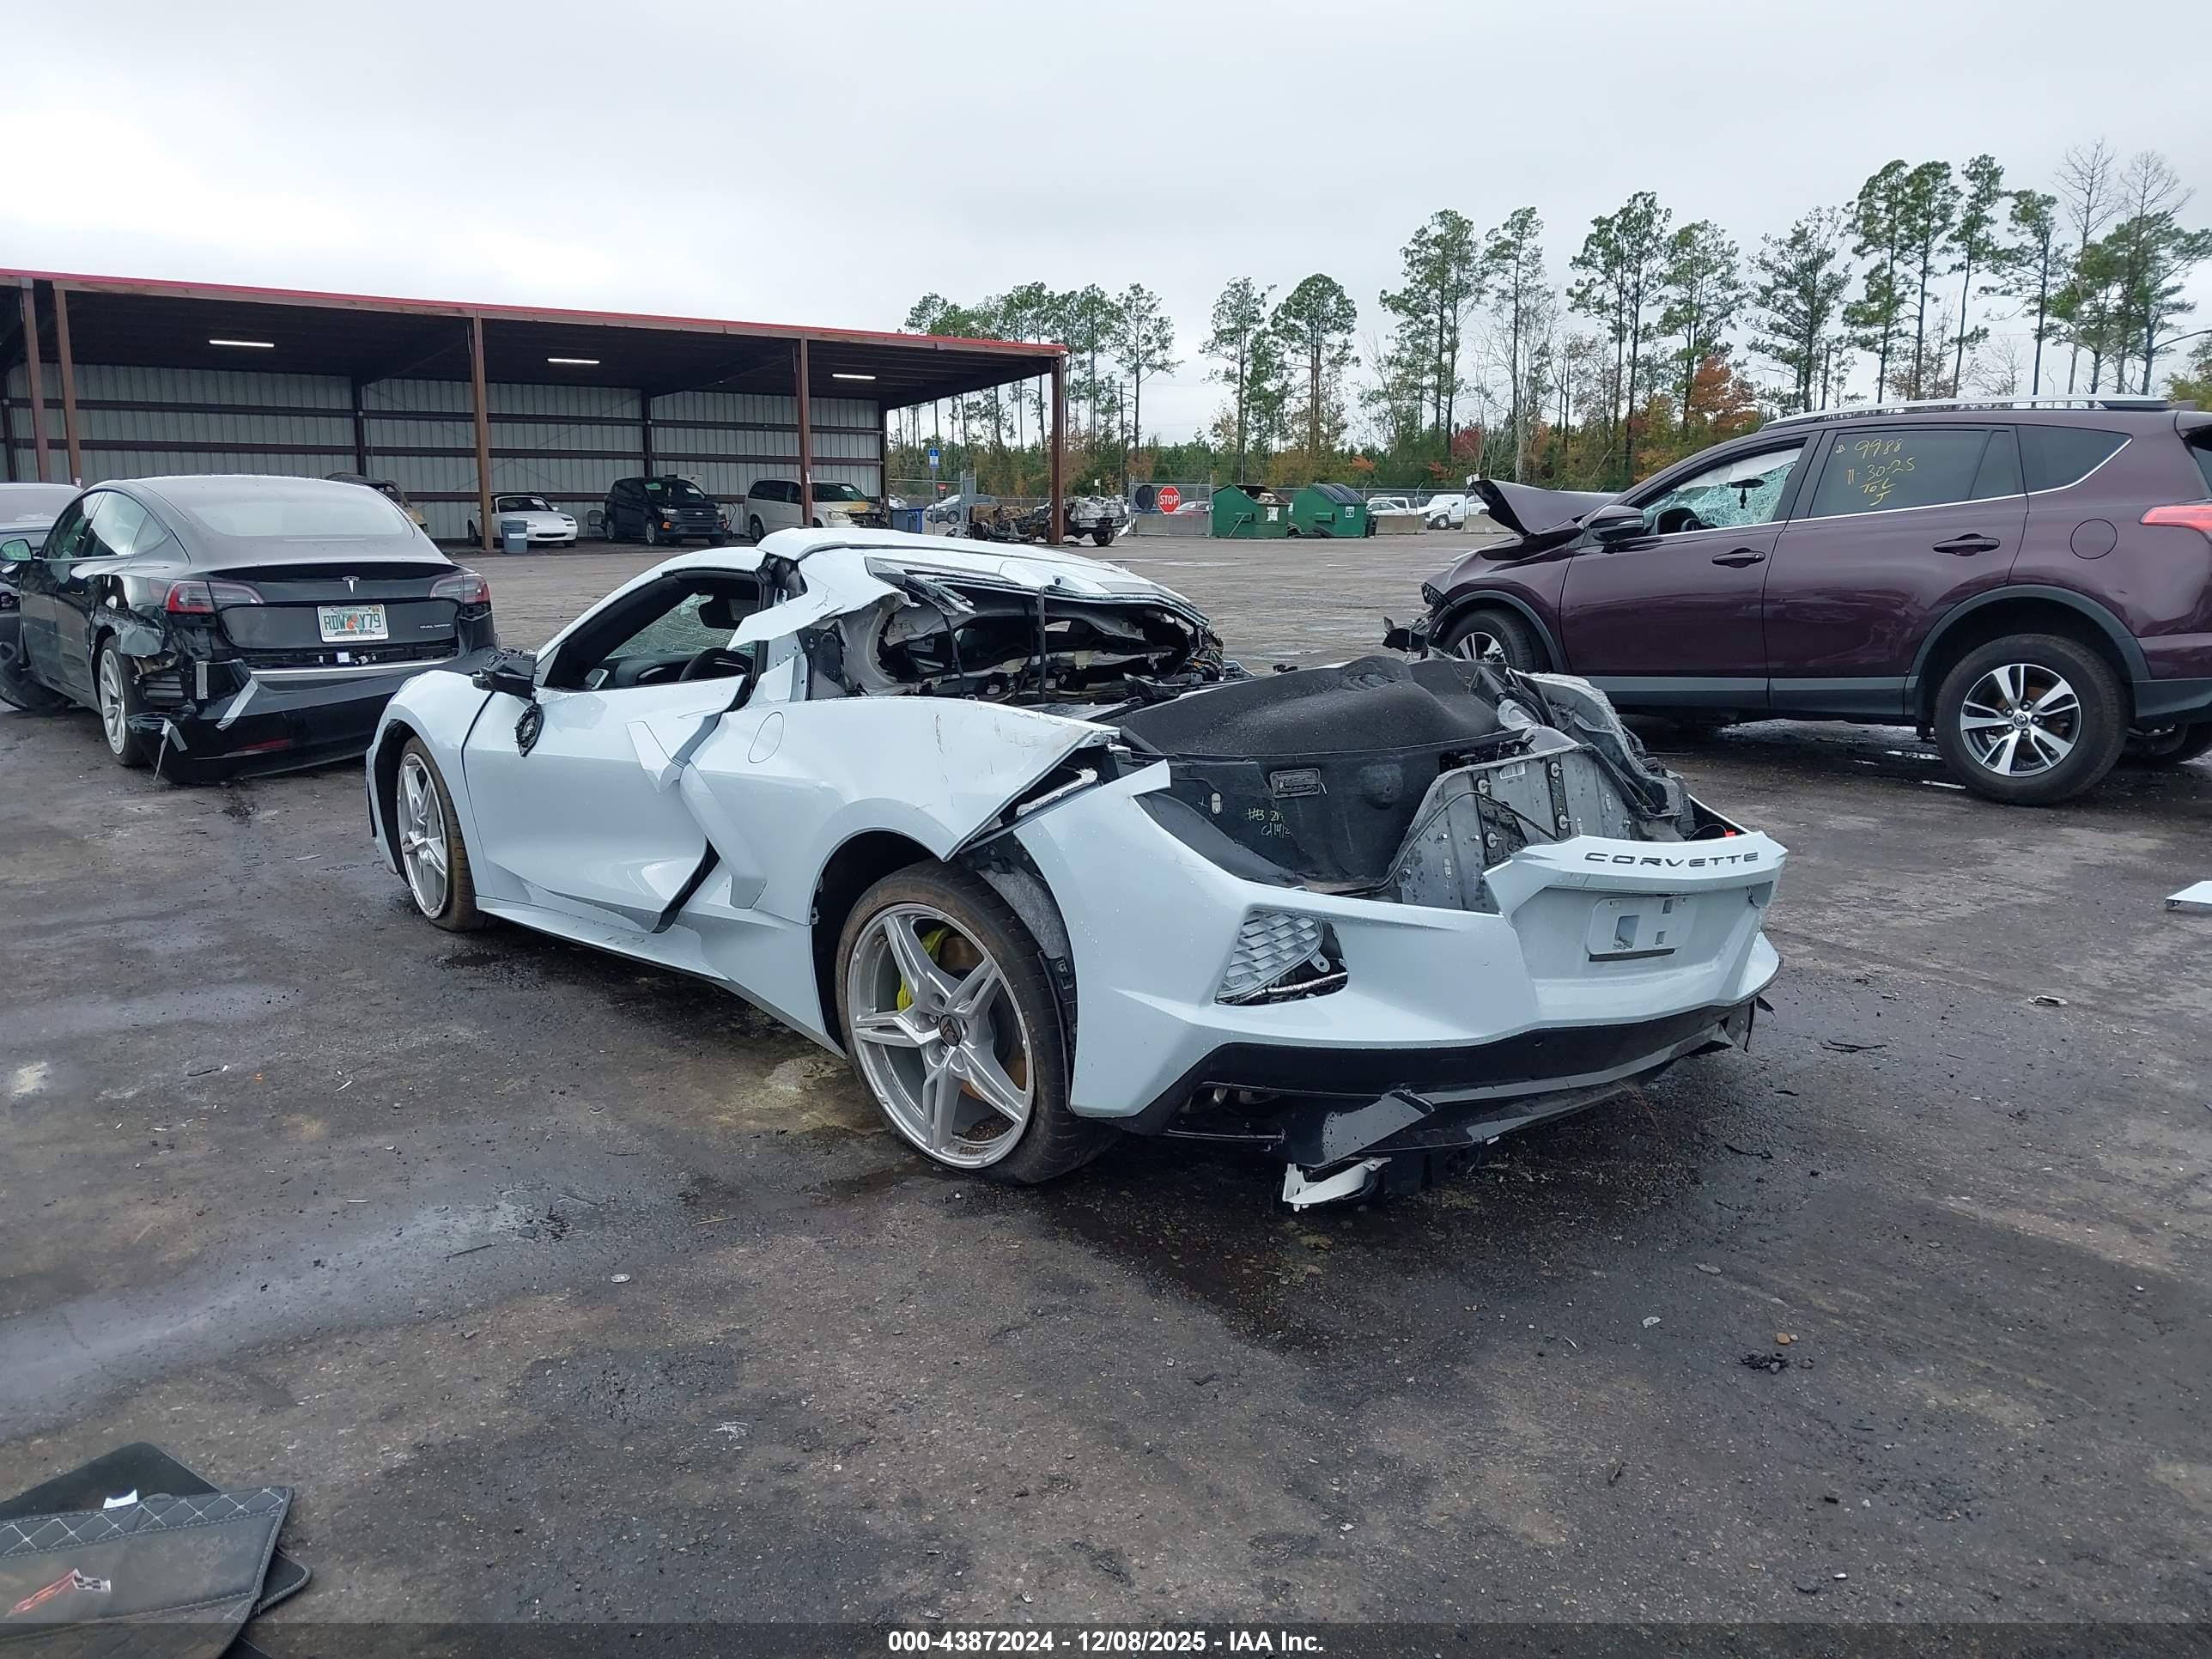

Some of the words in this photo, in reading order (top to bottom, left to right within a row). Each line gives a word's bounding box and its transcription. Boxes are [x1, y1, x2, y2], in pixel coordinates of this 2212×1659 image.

[1854, 436, 1904, 459] 9988
[1159, 495, 1179, 505] STOP
[1584, 851, 1759, 867] CORVETTE
